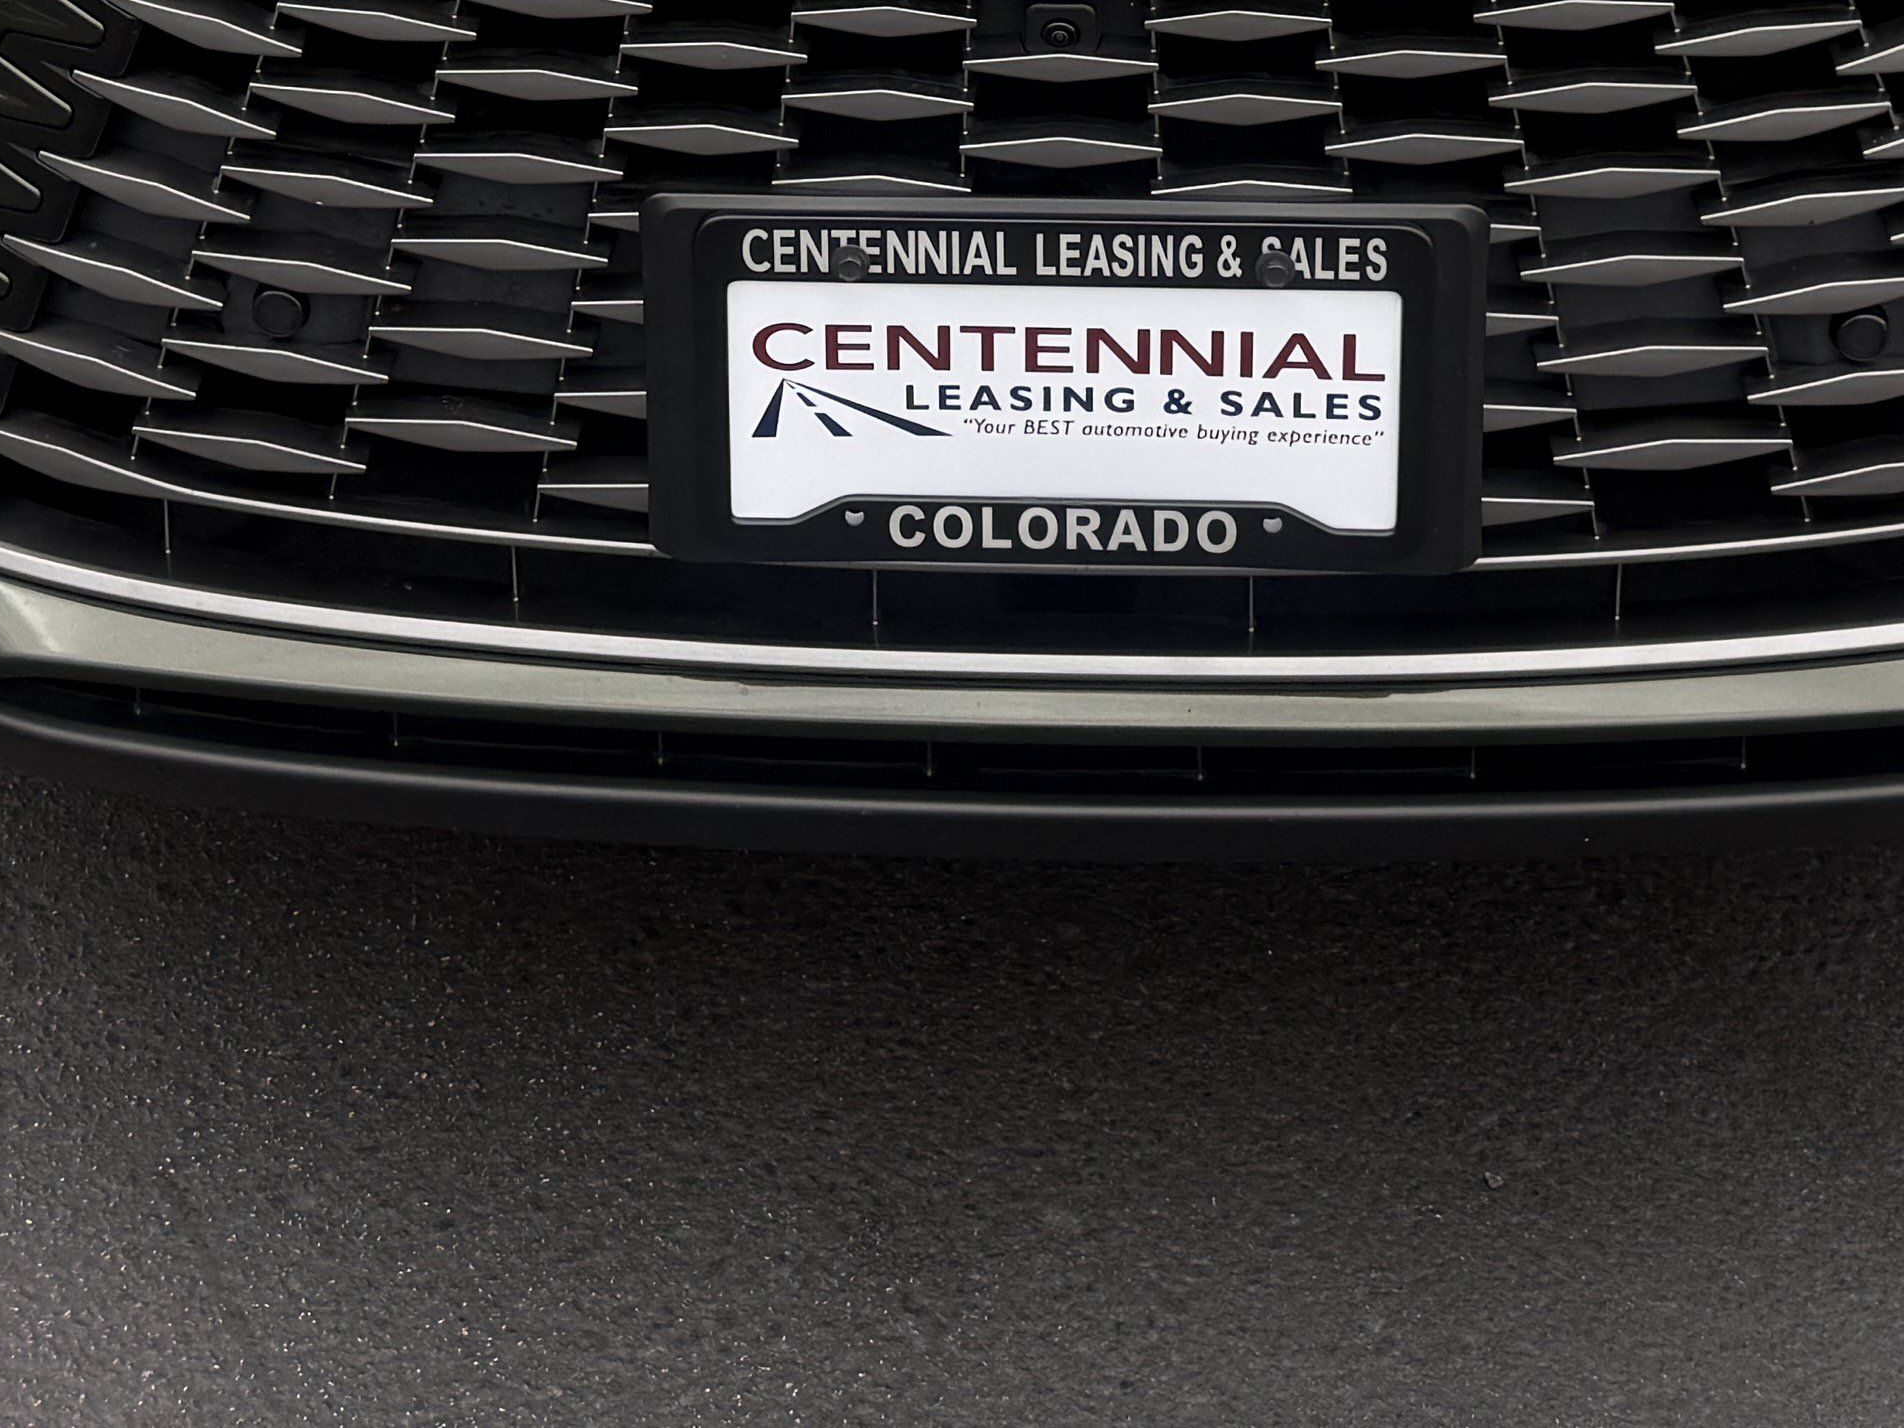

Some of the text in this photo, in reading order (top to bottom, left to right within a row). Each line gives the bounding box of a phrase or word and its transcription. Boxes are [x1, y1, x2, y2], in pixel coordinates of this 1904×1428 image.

[1036, 233, 1204, 278] LEASING
[1216, 234, 1243, 278] &
[752, 322, 1386, 382] CENTENNIAL
[905, 384, 1382, 421] LEASING & SALES
[1024, 419, 1076, 436] BEST
[1082, 421, 1188, 439] automotive
[1196, 424, 1259, 447] buying
[889, 505, 1237, 554] COLORADO
